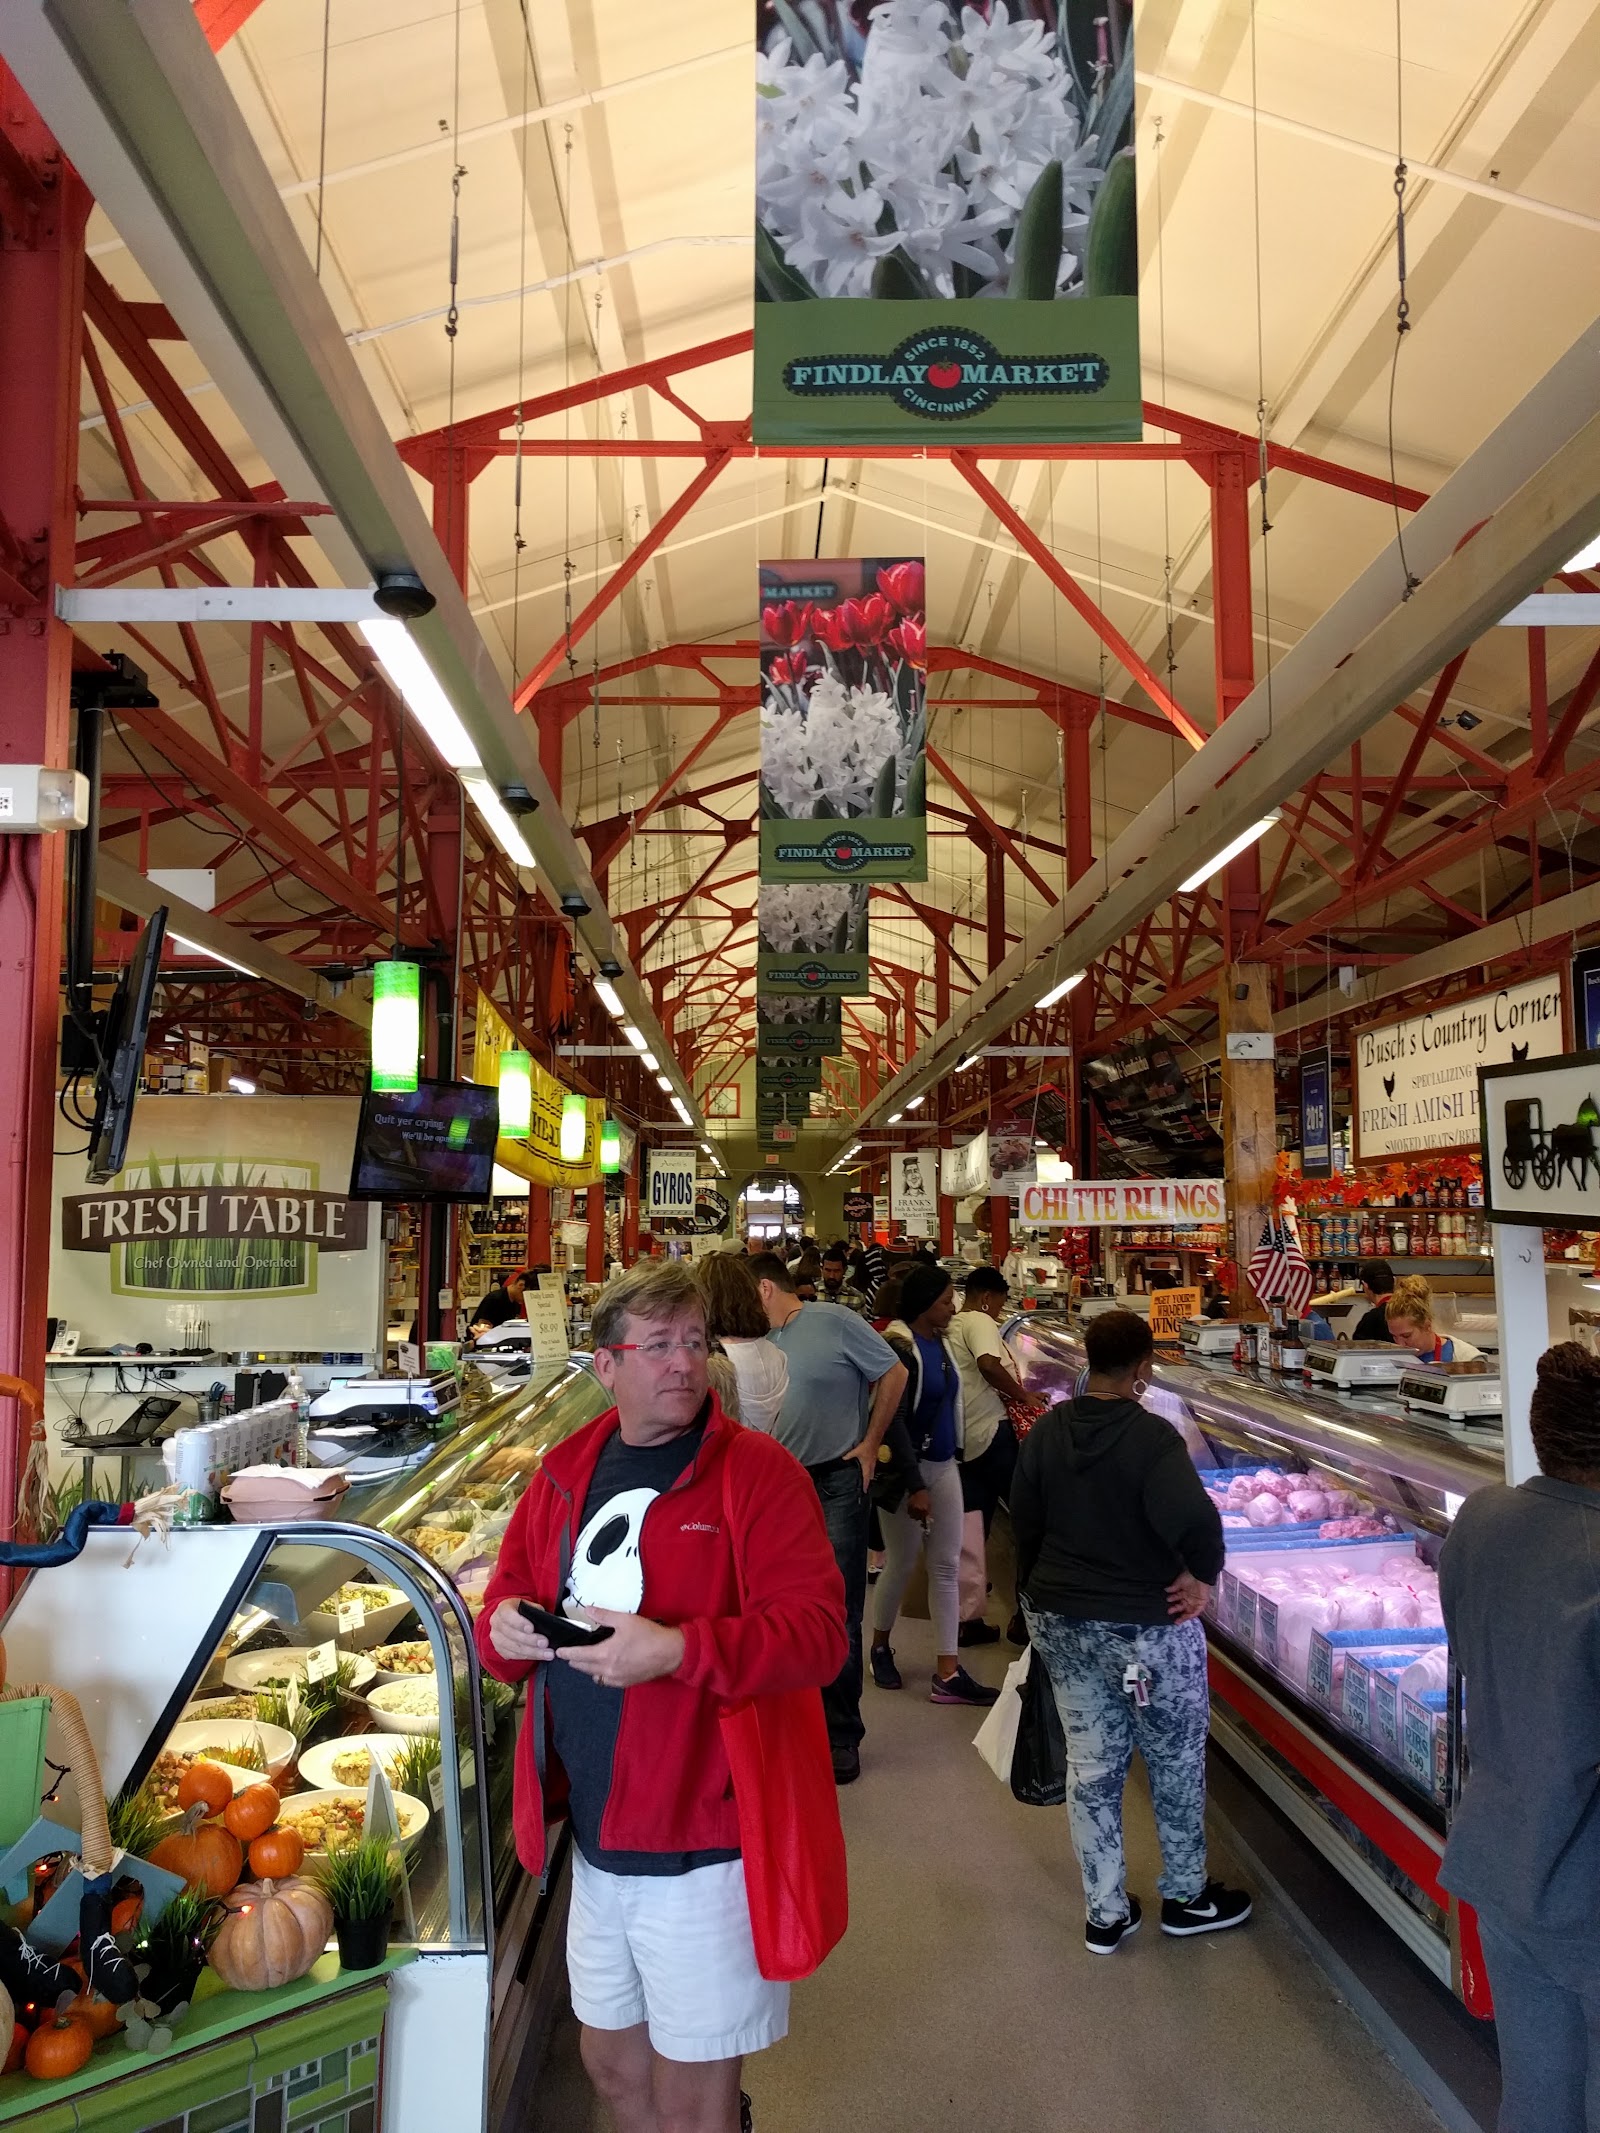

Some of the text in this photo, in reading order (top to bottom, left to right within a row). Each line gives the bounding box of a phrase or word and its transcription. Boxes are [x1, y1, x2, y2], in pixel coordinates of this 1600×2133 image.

[904, 336, 987, 362] SINCE 1852
[792, 362, 1100, 386] FINDLAY MARKET
[903, 387, 990, 414] CINCINNATI
[778, 847, 912, 858] FINDLAY MARKET
[817, 972, 858, 980] MARKET
[1361, 990, 1562, 1068] Busch's Country Corner
[1411, 1065, 1473, 1090] SPECIALIZING
[374, 1113, 396, 1125] Quit
[1306, 1104, 1324, 1131] 2015
[1362, 1103, 1408, 1133] FRESH
[1413, 1091, 1465, 1125] AMISH
[402, 1131, 422, 1141] We'll
[1385, 1137, 1423, 1154] SMOKED
[653, 1170, 692, 1206] GYROS
[898, 1199, 932, 1207] FRANK'S
[77, 1195, 347, 1240] FRESH TABLE
[133, 1256, 298, 1270] Chef Owned and Operated
[539, 1322, 558, 1334] $8.99
